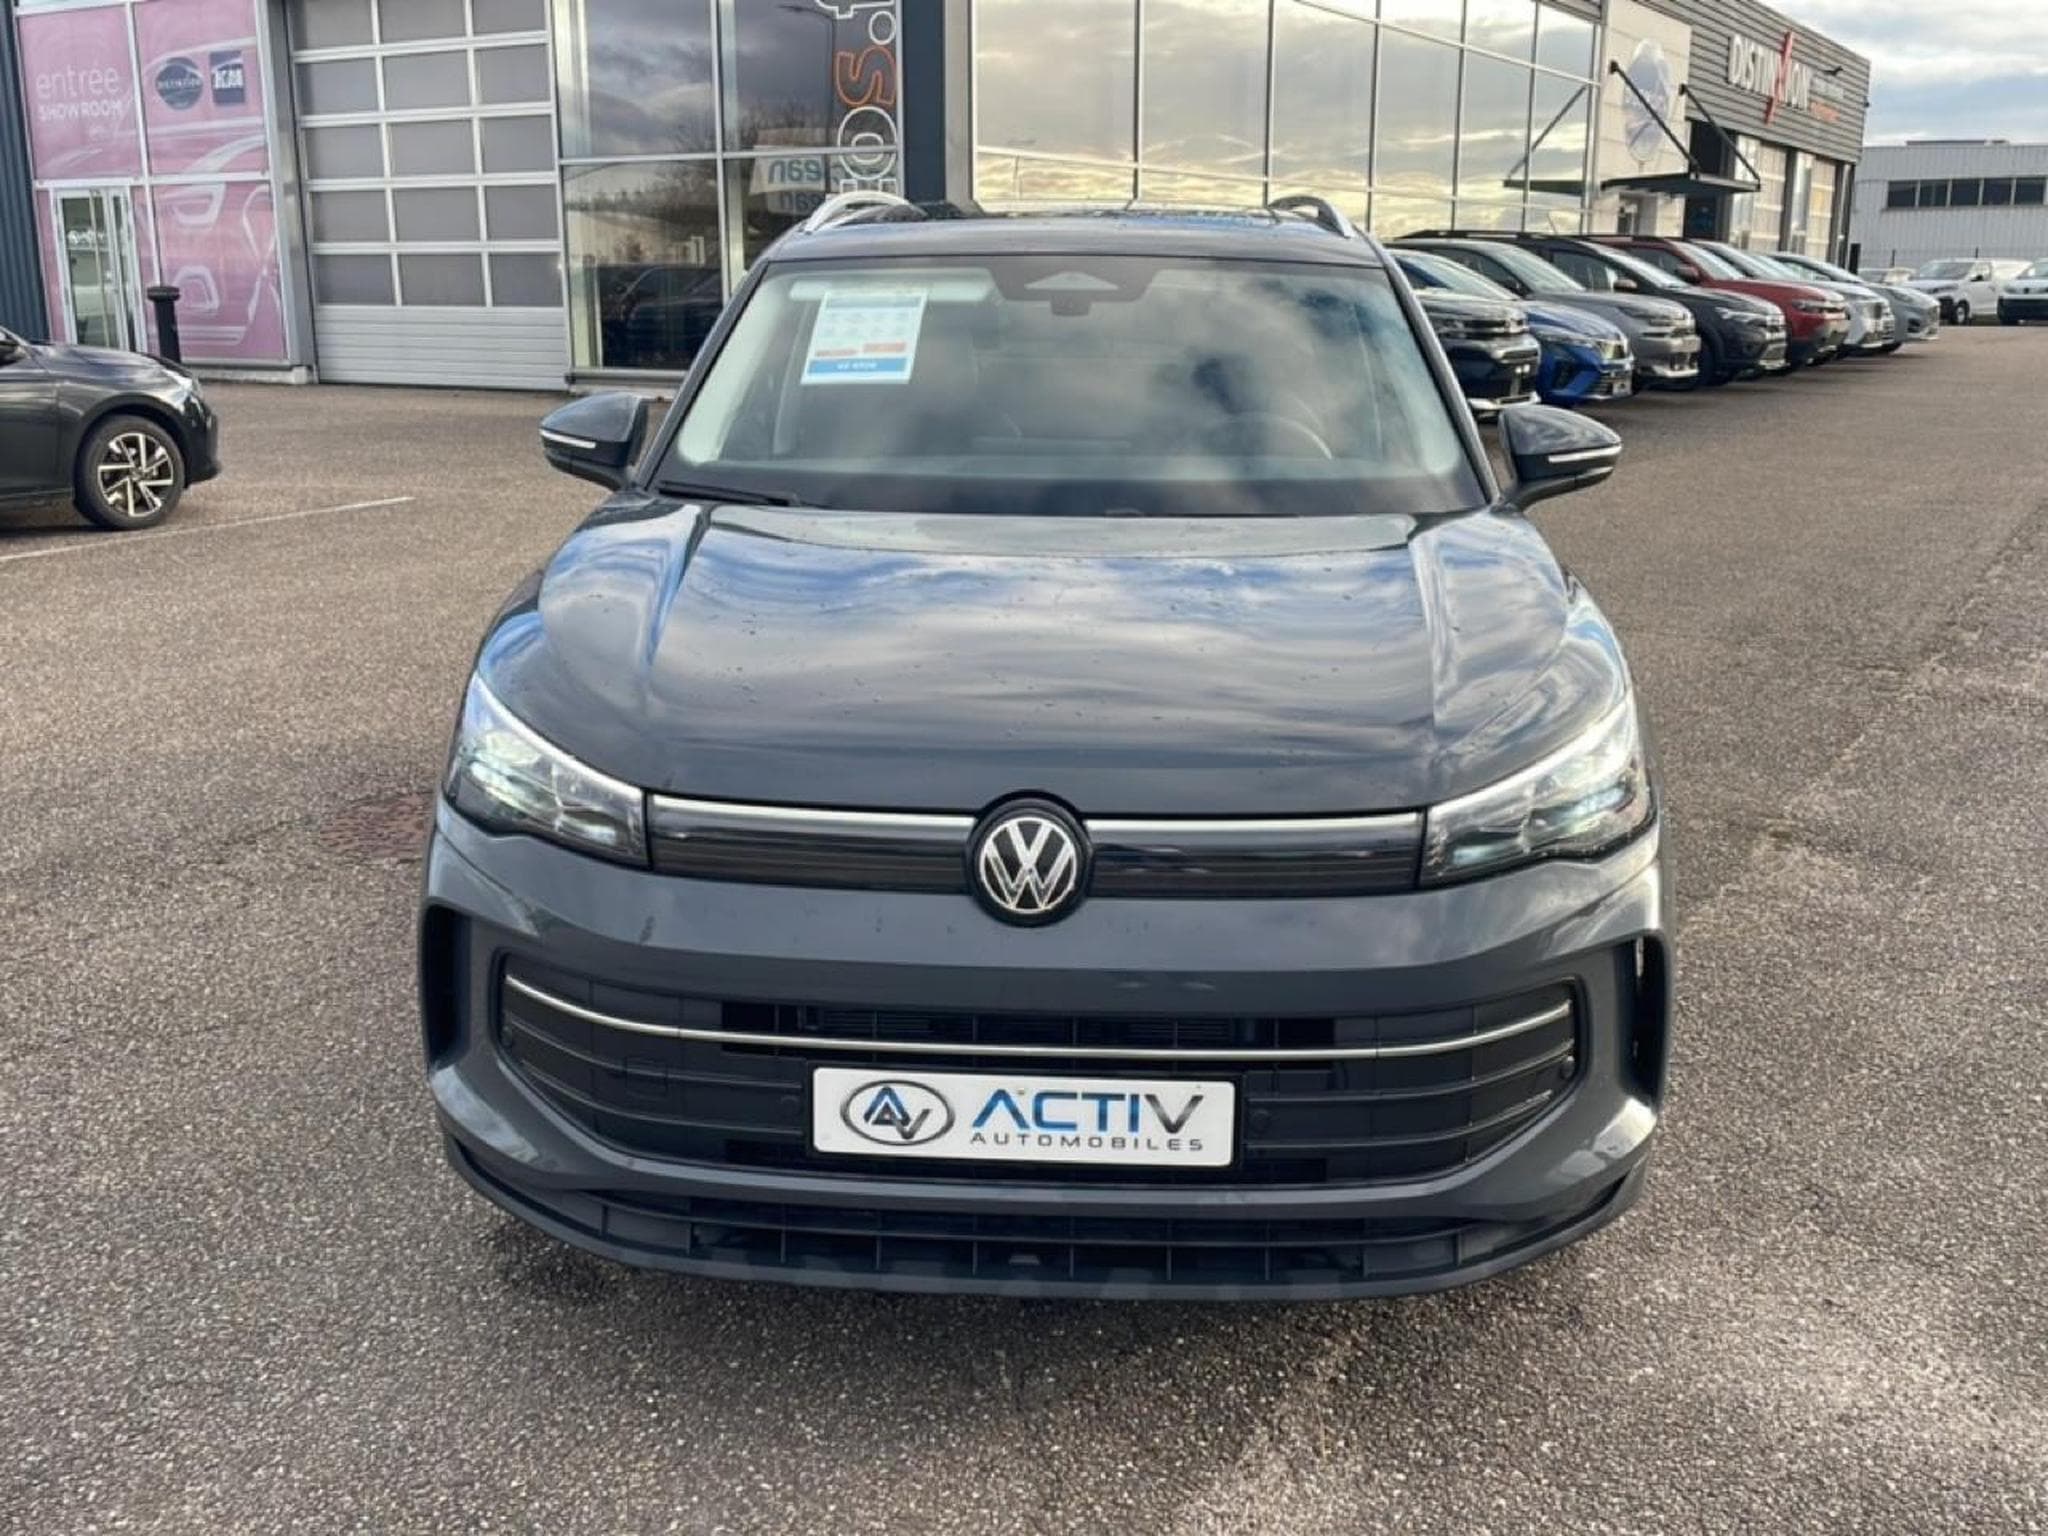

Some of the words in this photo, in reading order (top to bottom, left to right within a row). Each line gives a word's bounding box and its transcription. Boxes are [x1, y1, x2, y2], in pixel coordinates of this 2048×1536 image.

[38, 98, 123, 122] SHOWROOM
[971, 1088, 1205, 1134] ACTIV
[970, 1132, 1204, 1151] AUTOMOBILES
